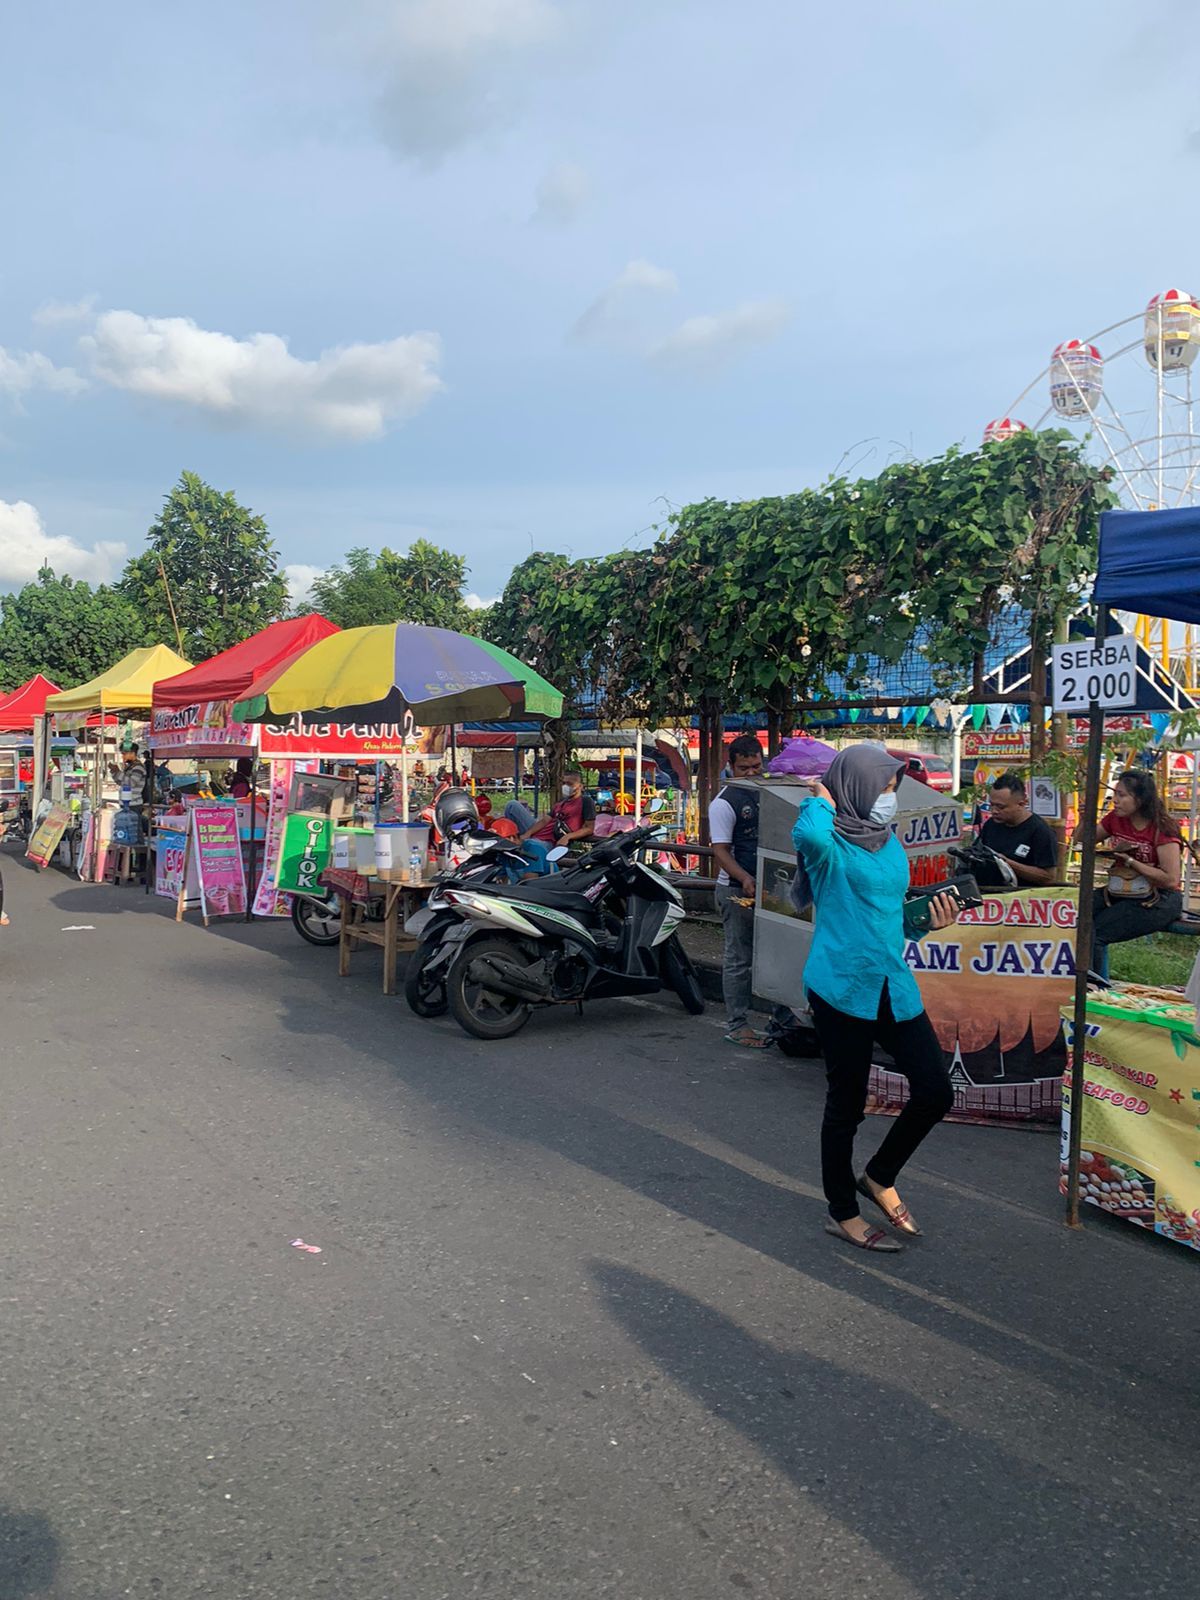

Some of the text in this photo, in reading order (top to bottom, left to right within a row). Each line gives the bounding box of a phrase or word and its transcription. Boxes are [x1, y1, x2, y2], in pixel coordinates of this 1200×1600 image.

[1060, 644, 1132, 671] SERBA
[1061, 671, 1131, 702] 2.000
[904, 809, 960, 844] JAYA
[297, 819, 324, 889] CILOK
[957, 898, 1077, 926] ADANG
[972, 941, 1077, 976] JAYA
[1083, 1079, 1150, 1115] EAFOOD
